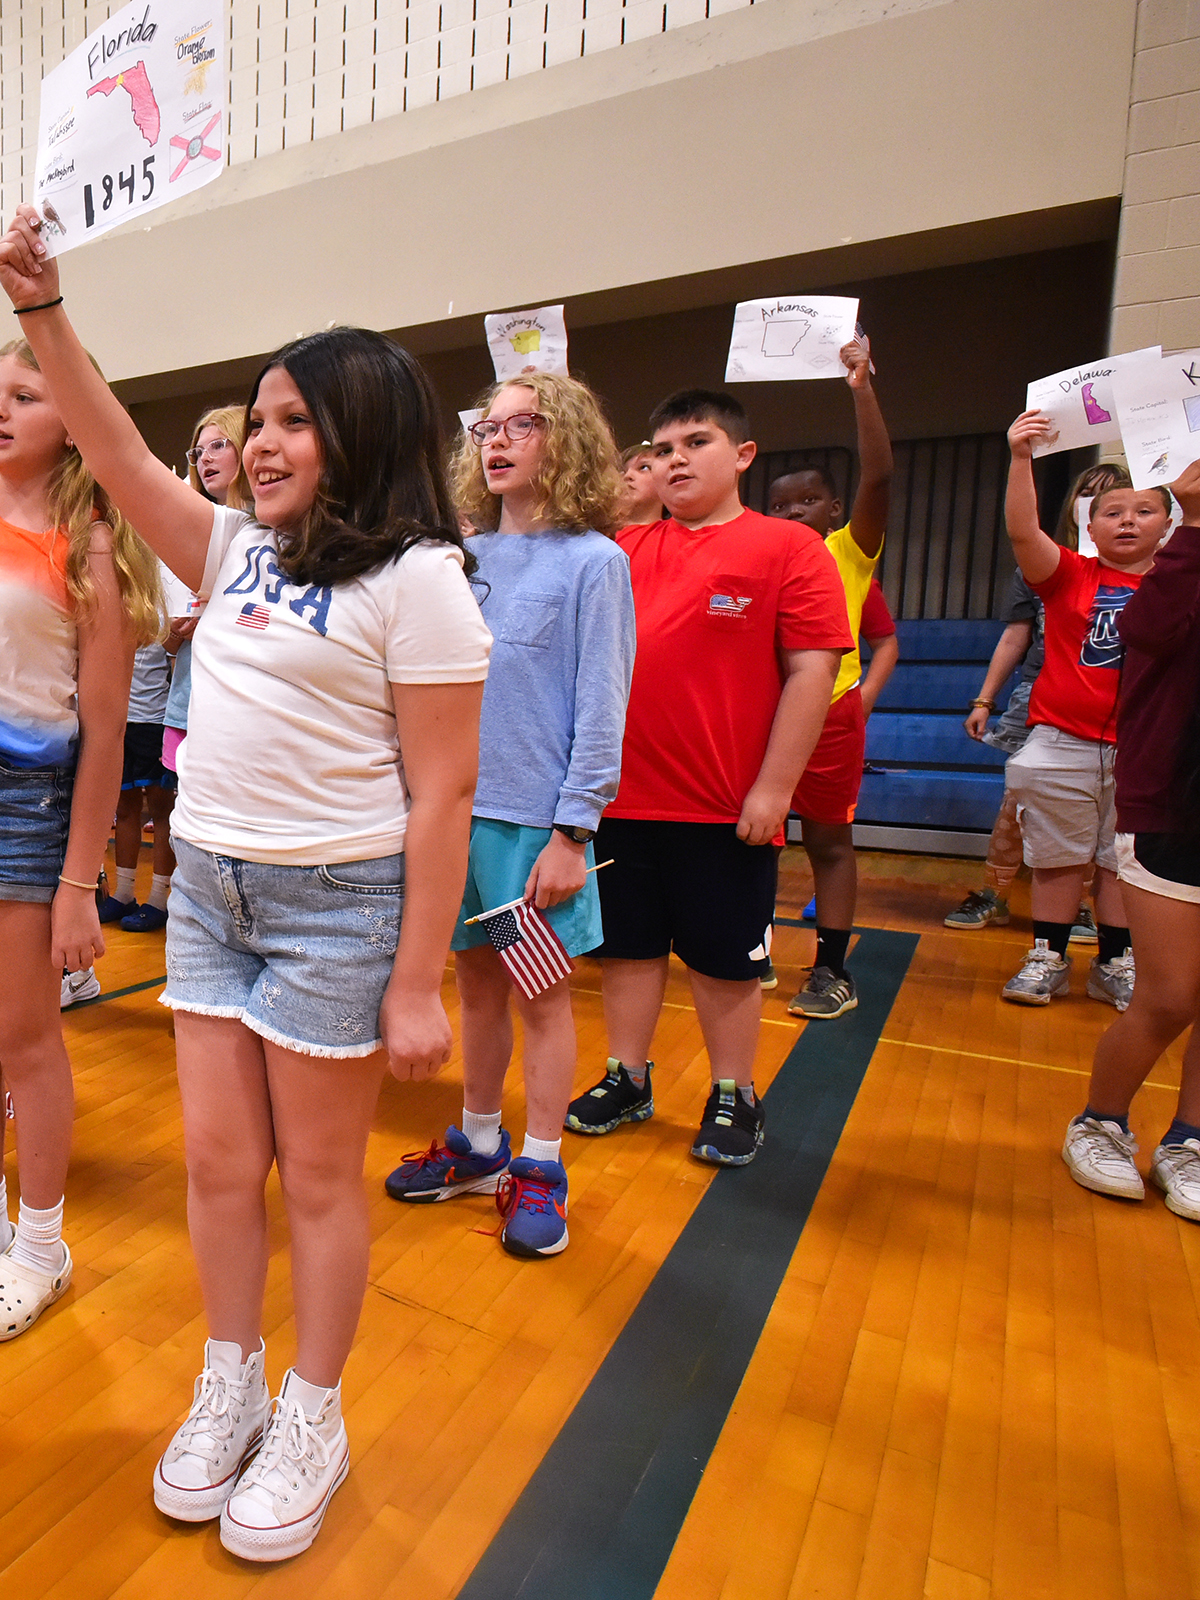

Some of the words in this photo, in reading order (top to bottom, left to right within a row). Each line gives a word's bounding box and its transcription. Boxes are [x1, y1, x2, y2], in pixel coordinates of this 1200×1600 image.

[87, 4, 158, 80] Florida
[84, 155, 155, 228] 1845
[496, 316, 546, 338] Washington
[761, 301, 819, 321] Arkansas
[223, 545, 333, 637] USA
